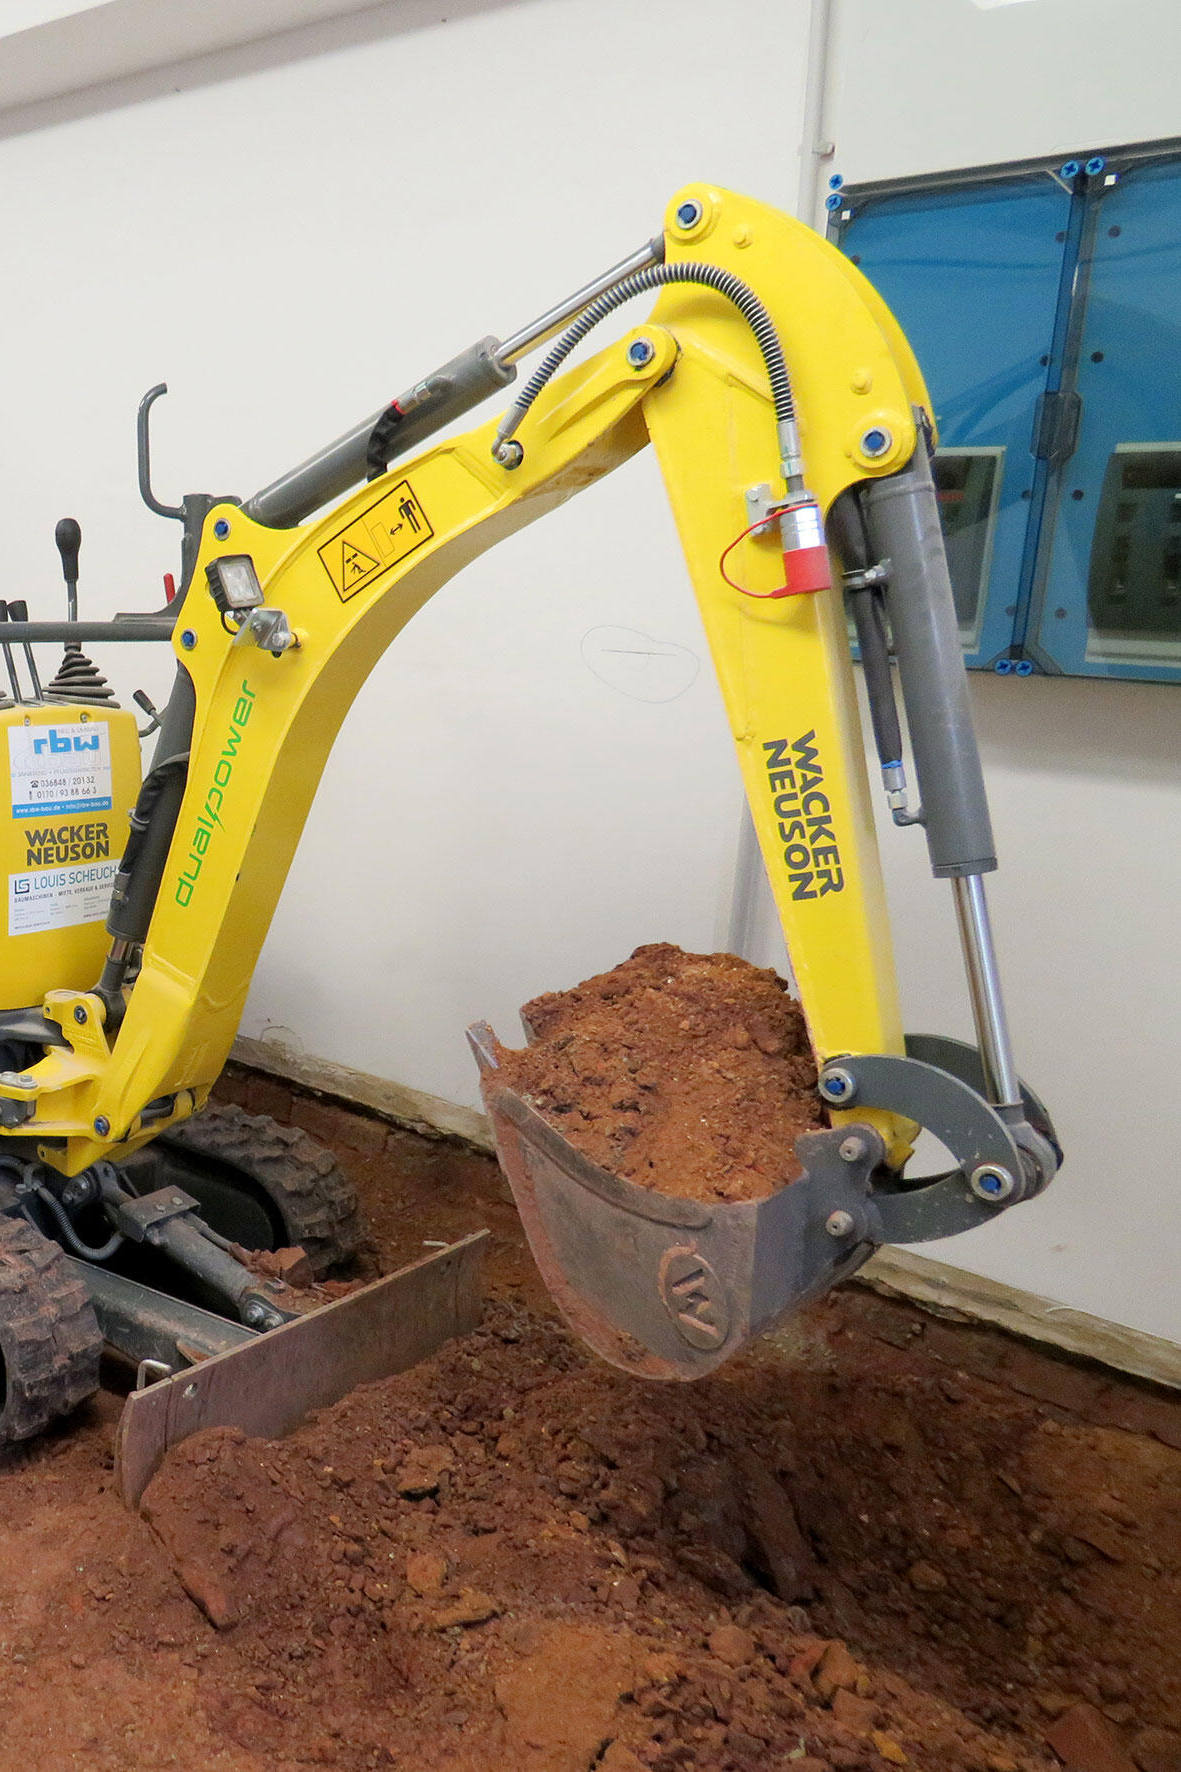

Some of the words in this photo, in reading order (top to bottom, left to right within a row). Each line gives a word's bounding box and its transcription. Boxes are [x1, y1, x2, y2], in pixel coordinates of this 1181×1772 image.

[33, 729, 99, 754] rbw
[73, 776, 95, 785] 20132
[175, 680, 257, 907] dualpower
[762, 738, 818, 901] NEUSON
[791, 729, 845, 898] WACKER
[25, 822, 109, 848] WACKER
[27, 840, 109, 866] NEUSON
[34, 873, 66, 890] LOUIS
[69, 865, 117, 885] SCHEUCH
